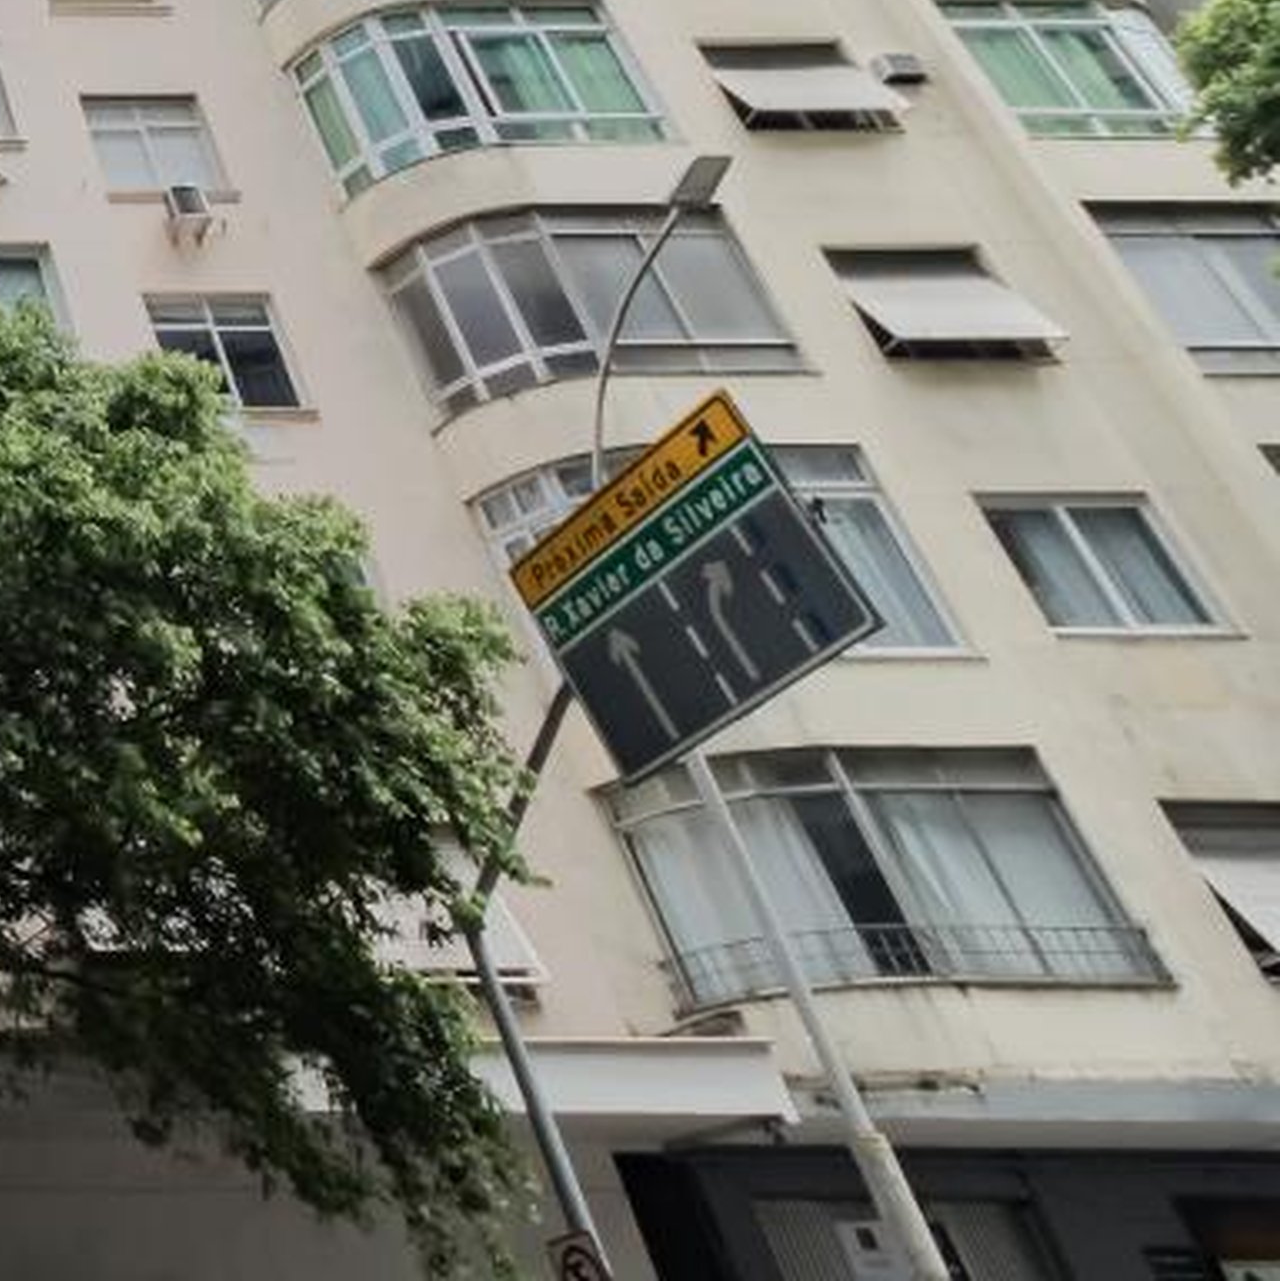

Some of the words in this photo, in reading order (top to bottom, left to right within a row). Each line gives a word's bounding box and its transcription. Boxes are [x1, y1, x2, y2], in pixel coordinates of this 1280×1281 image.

[561, 563, 631, 630] Xavier
[635, 538, 665, 570] da
[663, 461, 764, 545] Silveira
